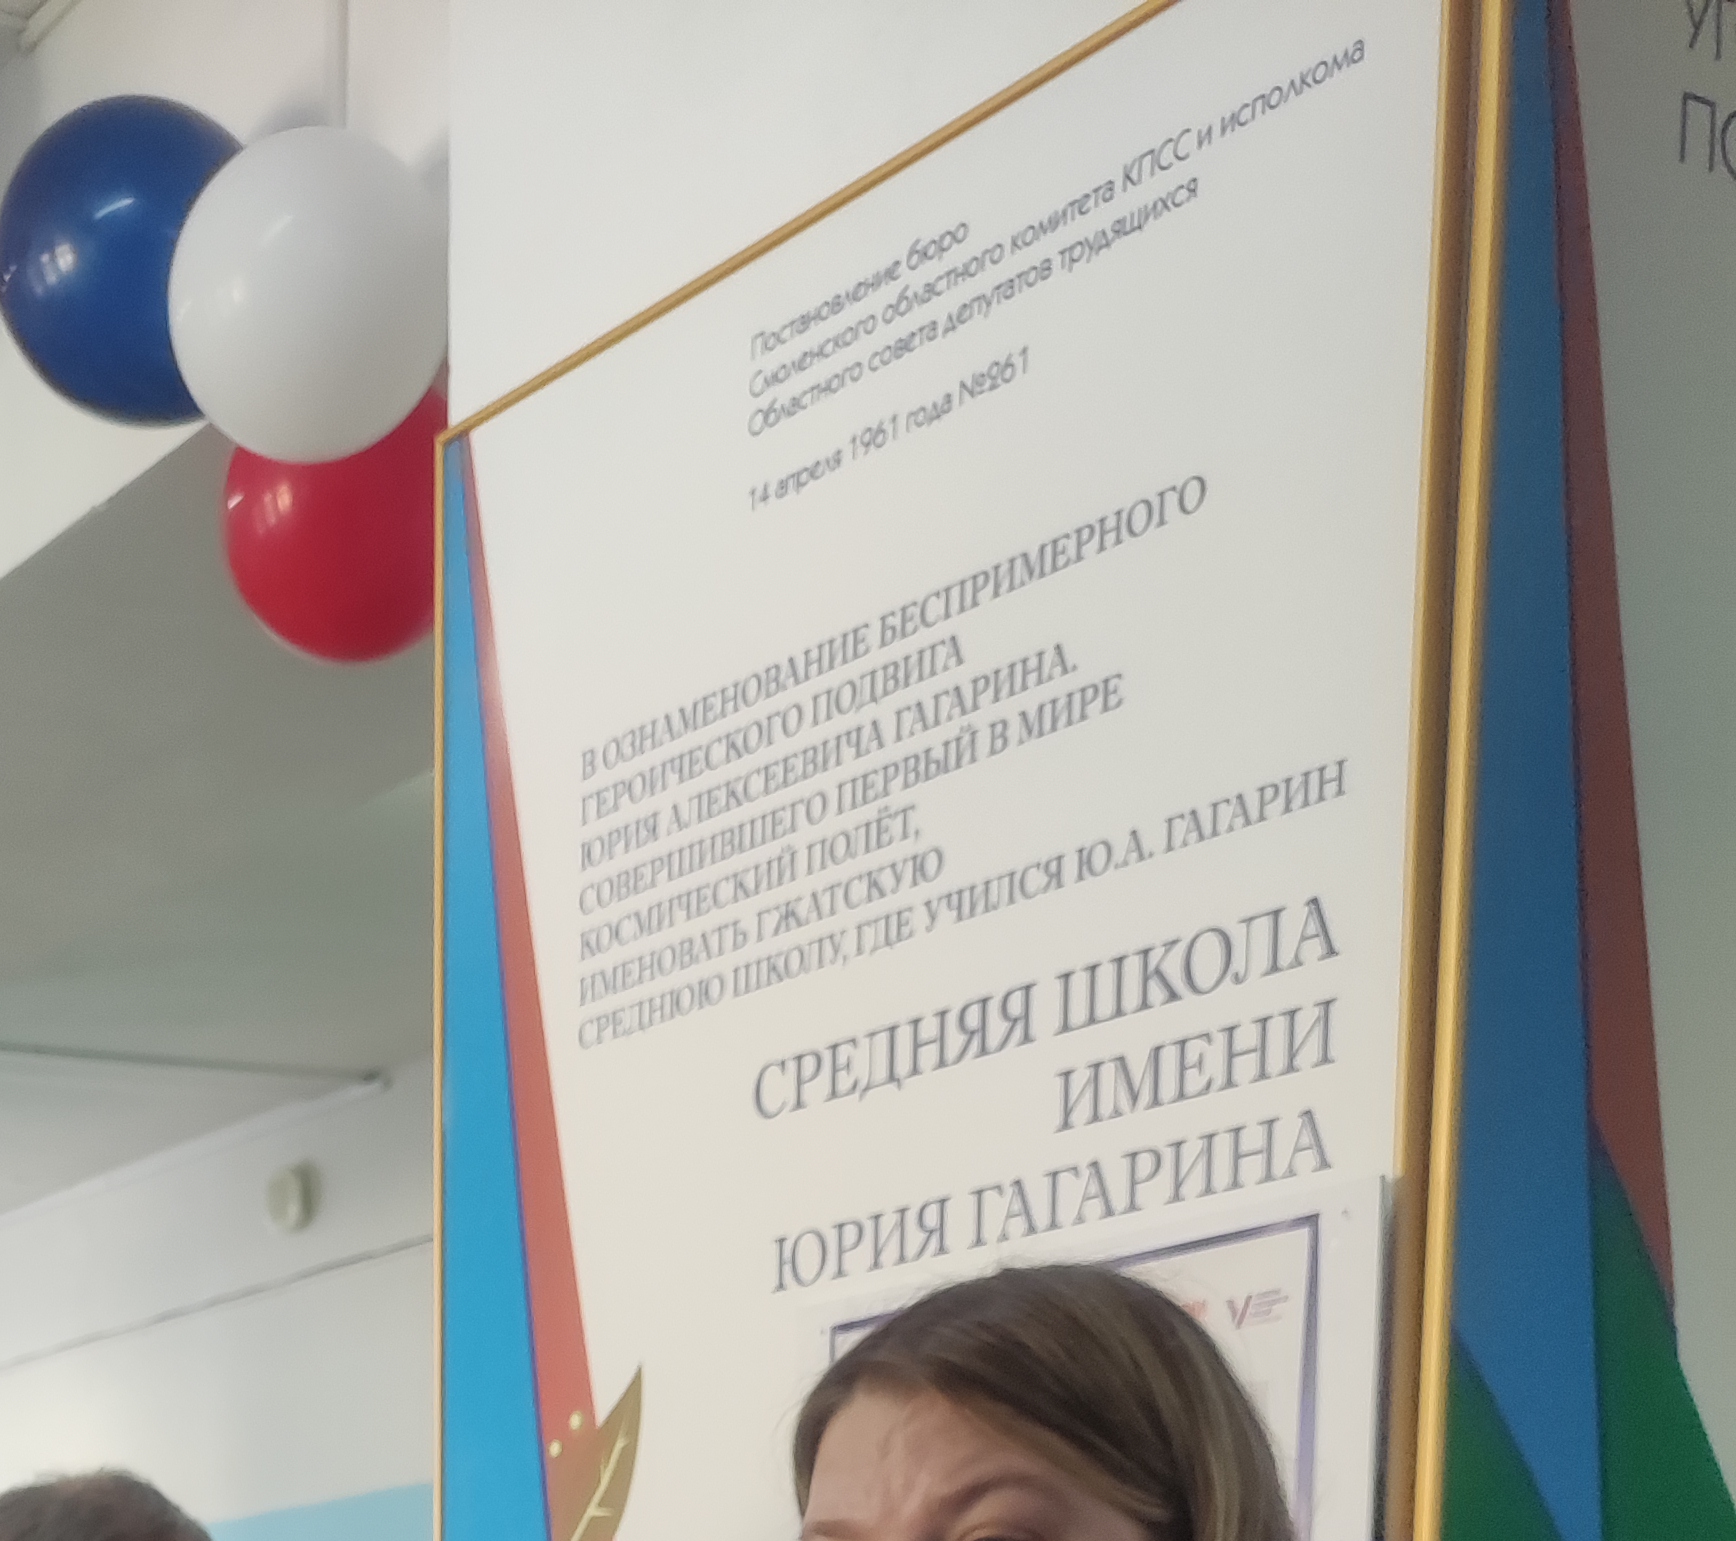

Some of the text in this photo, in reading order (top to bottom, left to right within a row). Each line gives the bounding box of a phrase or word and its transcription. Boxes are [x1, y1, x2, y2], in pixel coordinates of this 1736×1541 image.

[746, 174, 1201, 438] Областного совета депутатов трудящихся
[748, 37, 1367, 399] Смоленского областного комитета КПСС и исполкома
[749, 221, 970, 362] Постановление бюро
[747, 345, 1030, 511] 14 апреля 1961 года №261
[580, 474, 1209, 783] В ОЗНАМЕНОВАНИЕ БЕСПРИМЕРНОГО
[578, 672, 1126, 918] СОВЕРШИВШЕГО ПЕРВЫЙ В МИРЕ
[580, 633, 967, 828] ГЕРОИЧЕСКОГО ПОДВИГА
[580, 809, 662, 873] ЮРИЯ
[666, 718, 886, 837] АЛЕКСЕЕВИЧА
[577, 757, 1349, 1051] СРЕДНЮЮ ШКОЛУ, ГДЕ УЧИЛСЯ Ю.А. ГАГАРИН
[578, 803, 922, 963] КОСМИЧЕСКИЙ ПОЛЁТ,
[578, 845, 945, 1008] ИМЕНОВАТЬ ГЖАТСКУЮ
[753, 895, 1339, 1121] СРЕДНЯЯ ШКОЛА
[1053, 997, 1338, 1134] ИМЕНИ
[770, 1107, 1333, 1295] ЮРИЯ ГАГАРИНА
